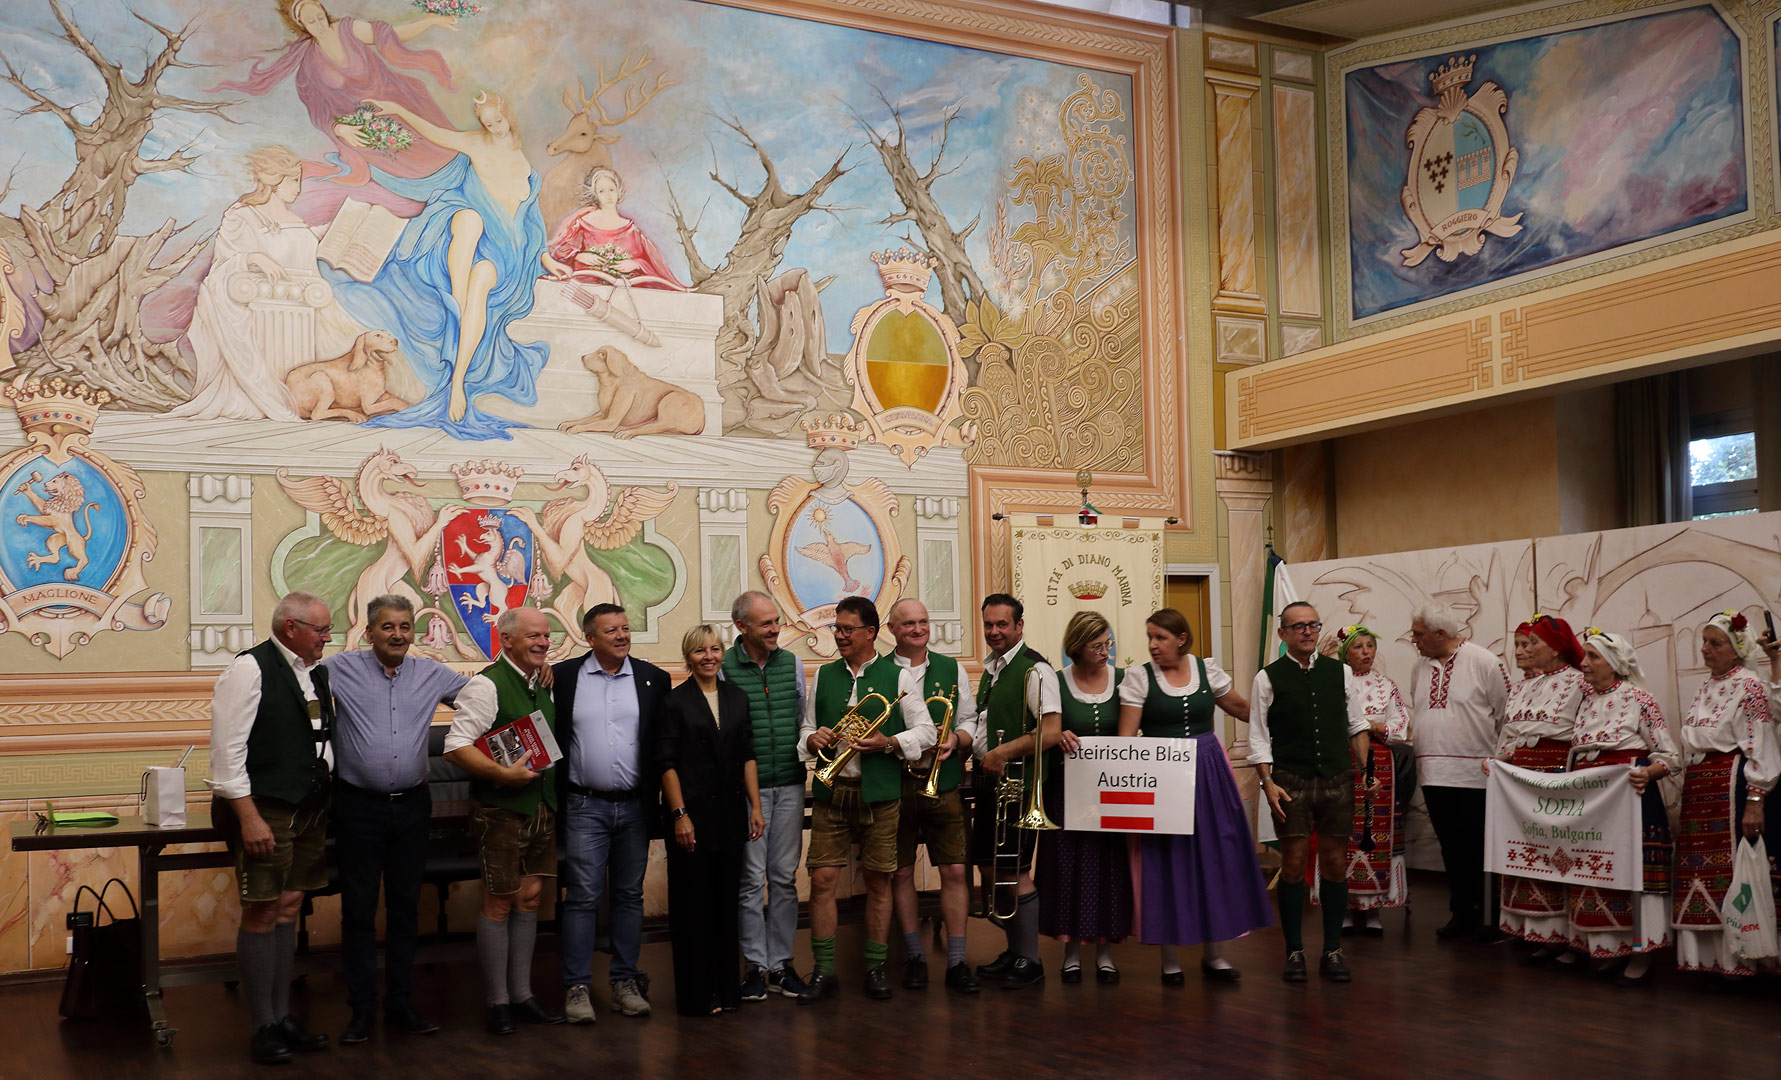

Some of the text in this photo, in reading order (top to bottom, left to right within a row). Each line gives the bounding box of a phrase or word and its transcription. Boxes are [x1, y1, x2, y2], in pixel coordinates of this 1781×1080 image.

[1441, 213, 1478, 232] ROGGIERO
[1061, 557, 1074, 570] DI
[1077, 554, 1111, 568] DIANO
[1111, 565, 1132, 607] MARINA
[22, 588, 98, 605] MAGLIONE
[1156, 746, 1191, 762] Blas
[1097, 771, 1157, 788] Austria
[1572, 775, 1610, 790] Choir
[1532, 795, 1585, 817] SOFIA
[1521, 820, 1603, 844] Sofia, Bulgaria
